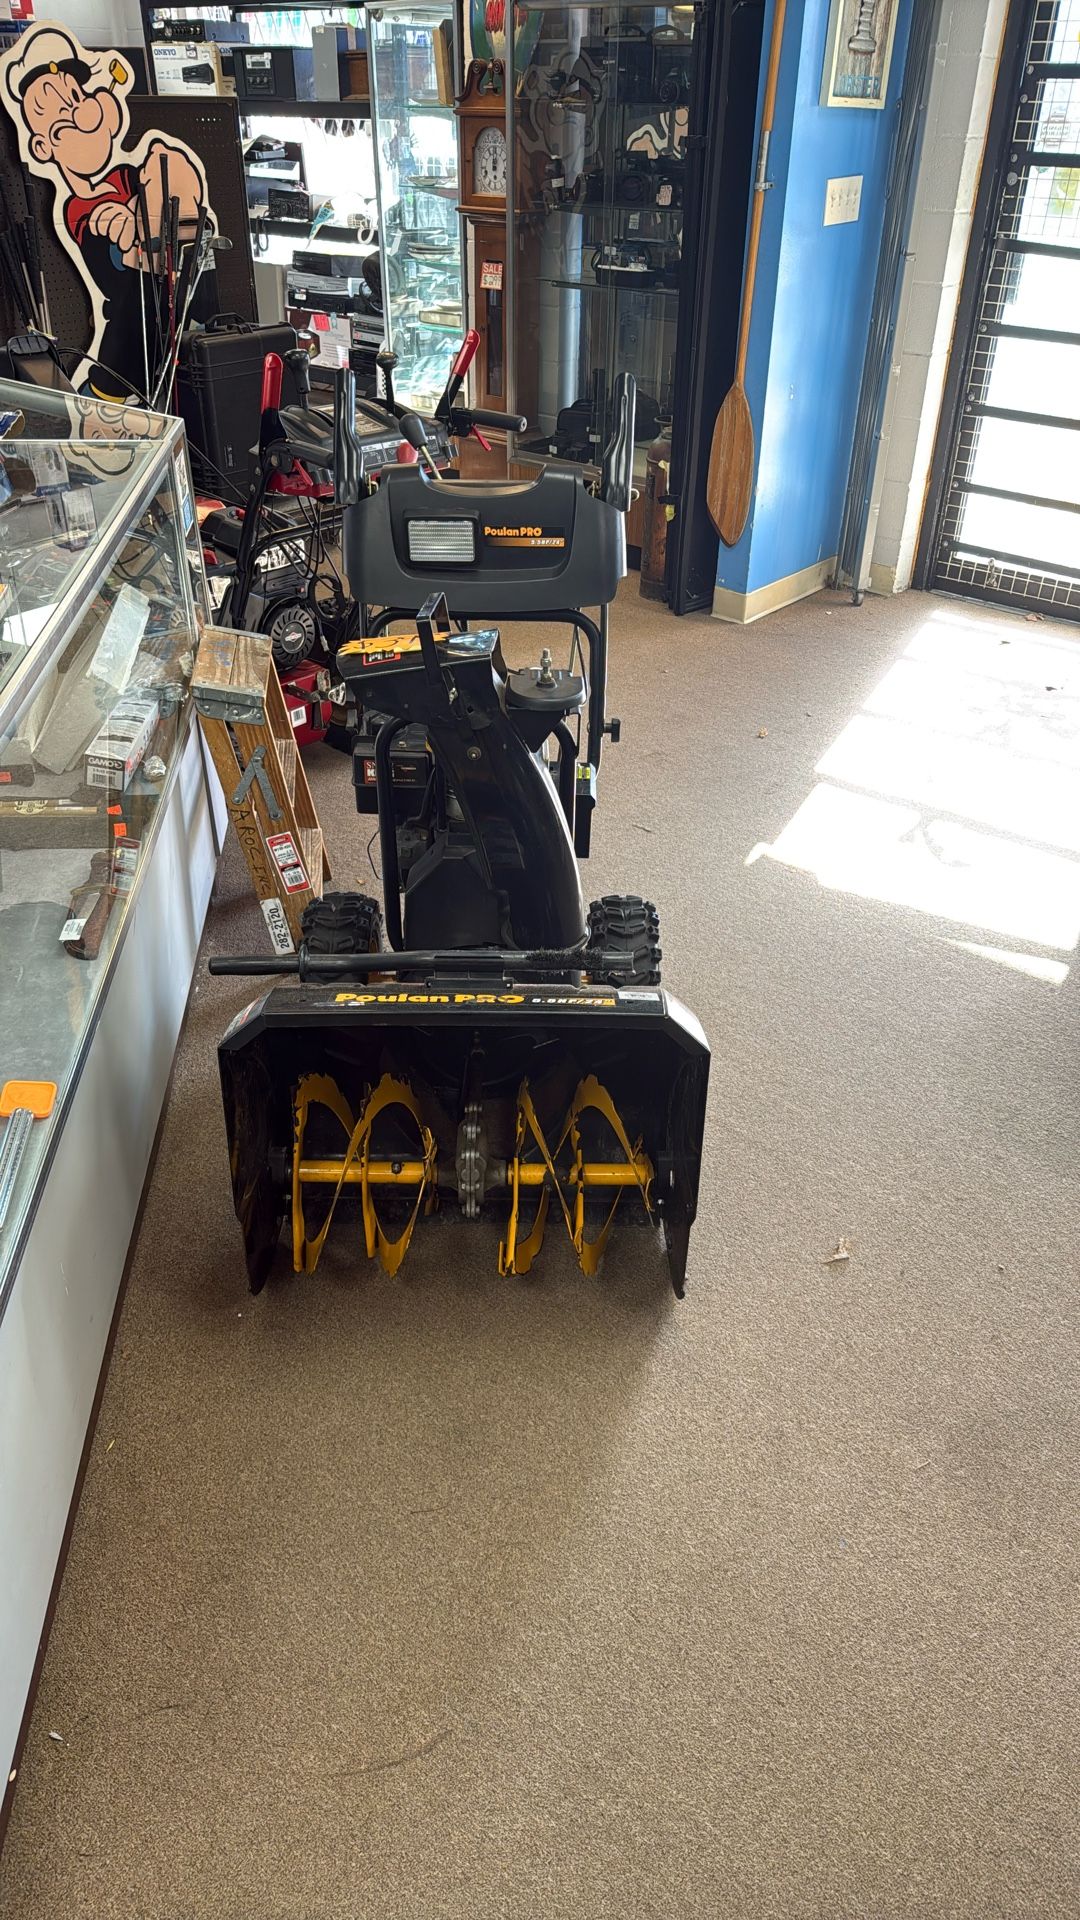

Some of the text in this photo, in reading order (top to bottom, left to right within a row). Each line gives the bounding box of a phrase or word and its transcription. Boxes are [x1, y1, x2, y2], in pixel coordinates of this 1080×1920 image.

[153, 48, 177, 56] ONKYO
[483, 263, 503, 275] SALE
[484, 526, 542, 537] Poulan PRO
[87, 757, 114, 768] GAMO
[269, 907, 290, 950] 282-2120
[335, 993, 449, 1004] Poulan
[454, 994, 525, 1004] PRO
